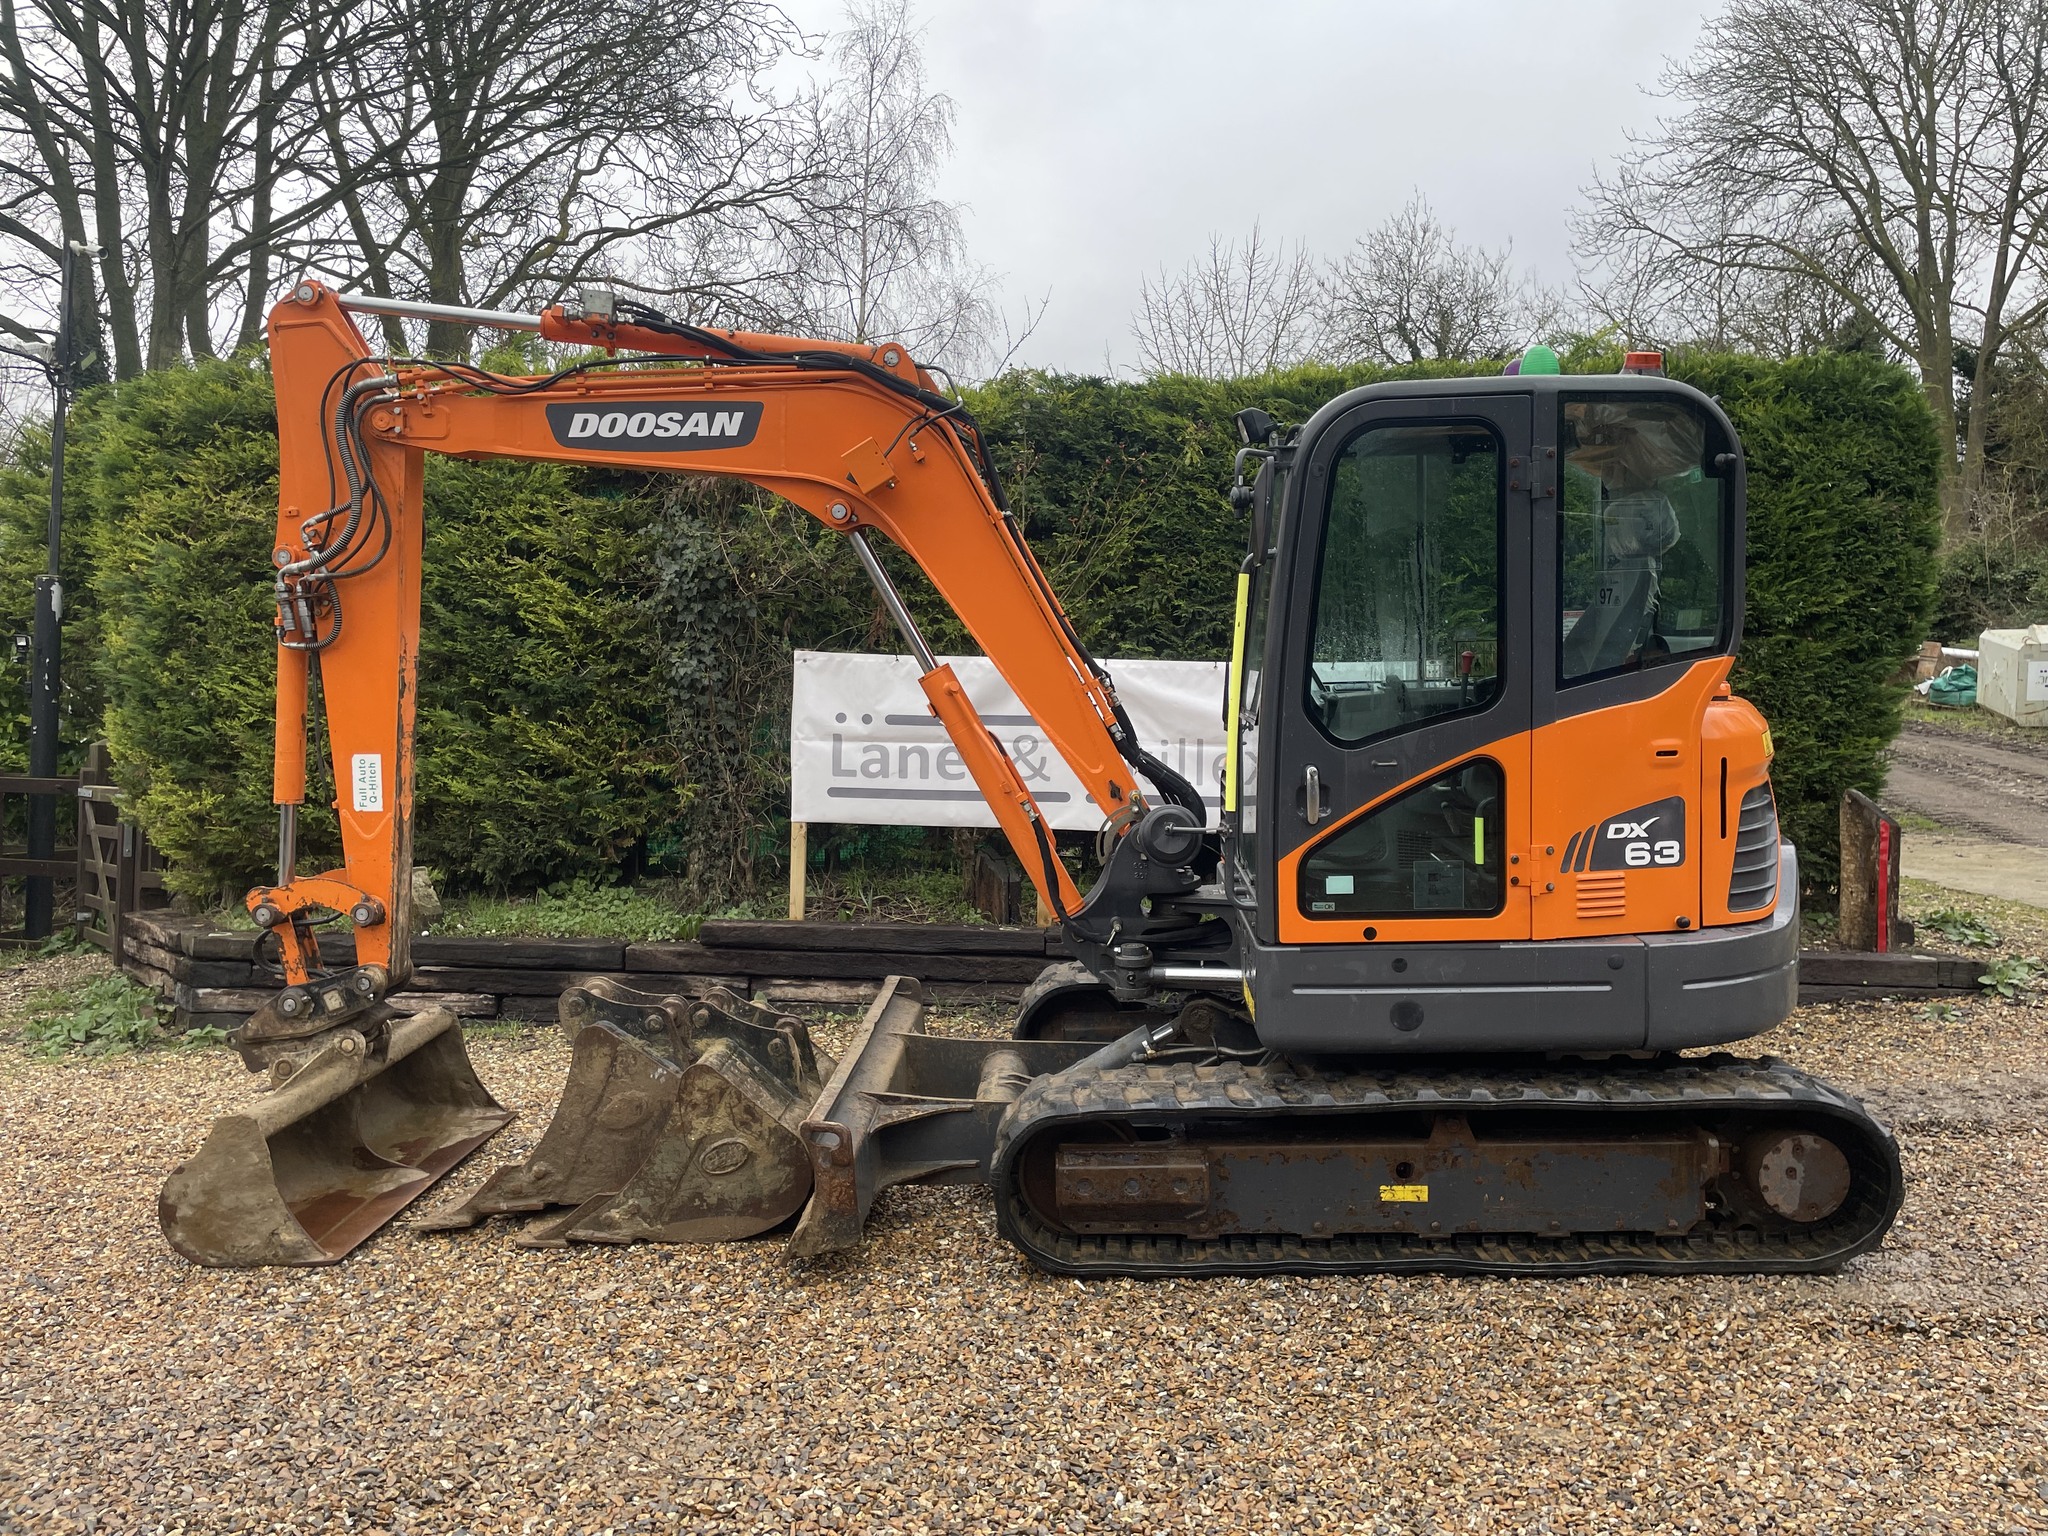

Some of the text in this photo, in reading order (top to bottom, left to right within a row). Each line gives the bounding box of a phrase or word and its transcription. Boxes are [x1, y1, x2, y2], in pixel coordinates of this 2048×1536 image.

[567, 411, 745, 438] DOOSAN
[1599, 588, 1613, 605] 97
[831, 733, 966, 781] Lane
[1010, 734, 1051, 782] &
[358, 758, 368, 808] Full Auto
[368, 762, 378, 804] Q-Hitch
[1606, 816, 1661, 839] DX
[1625, 840, 1680, 866] 63
